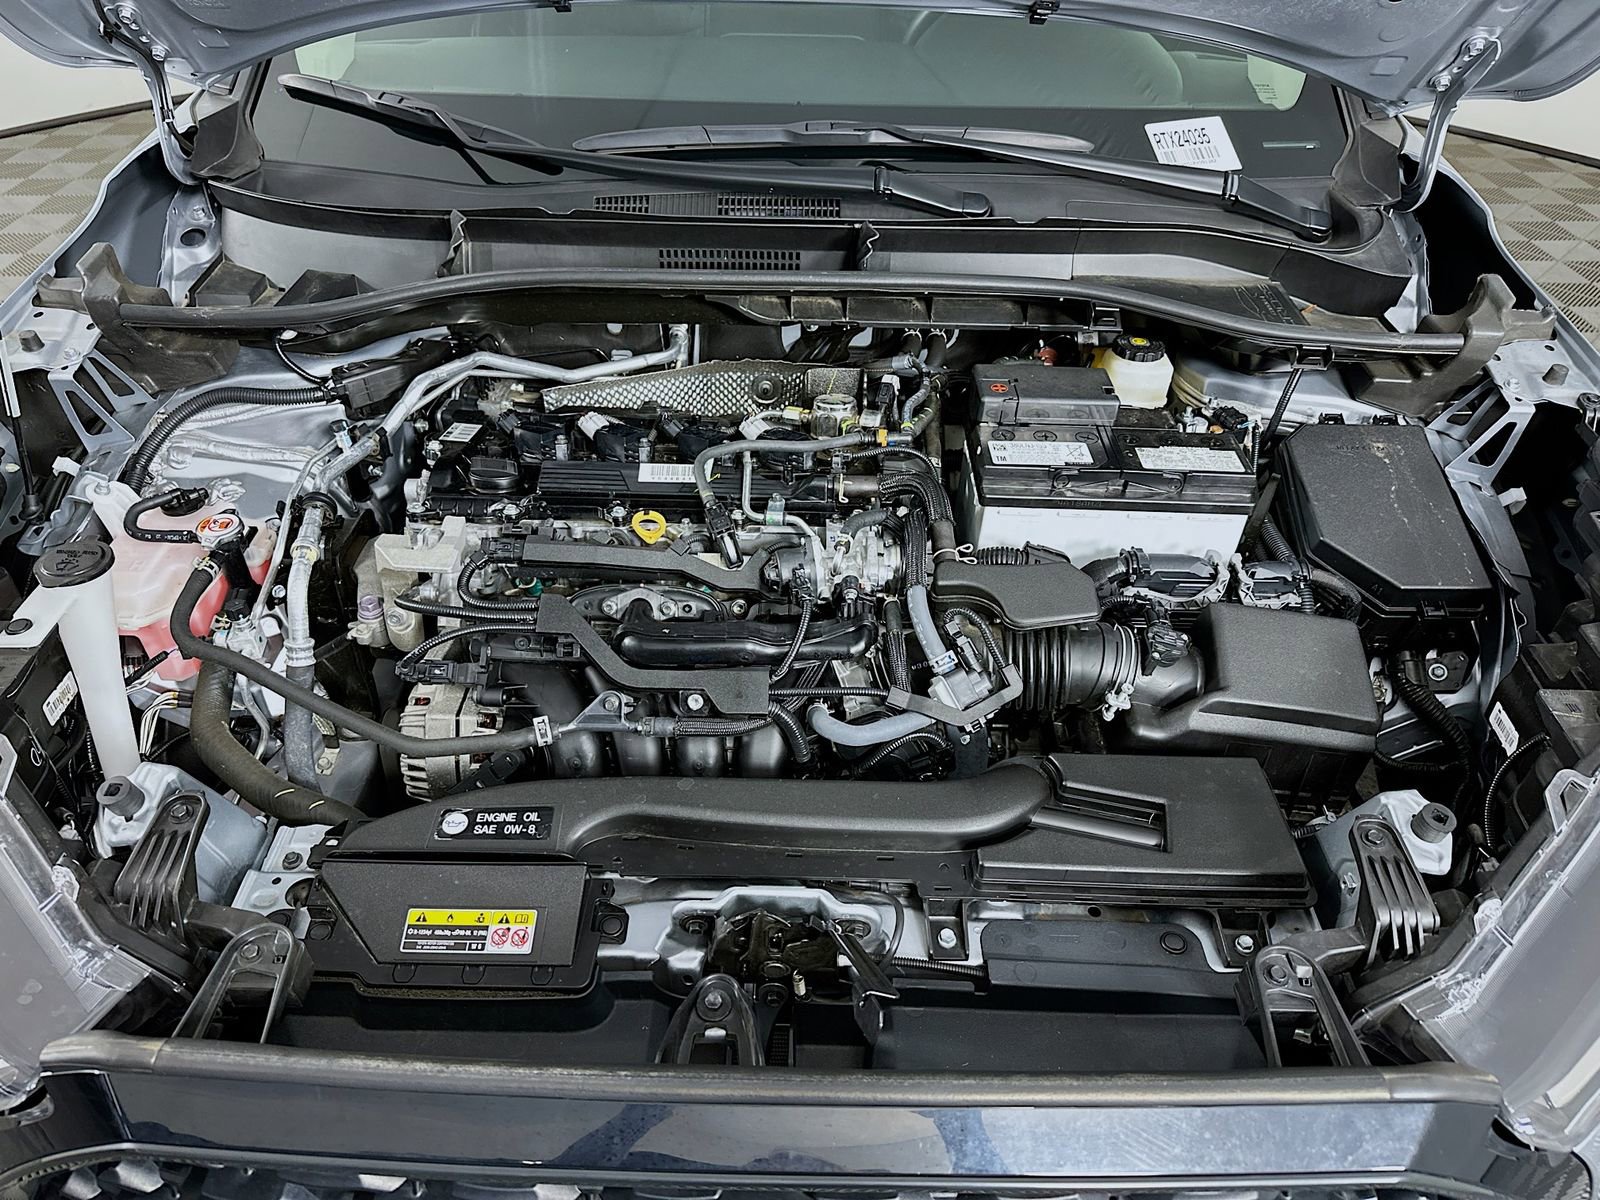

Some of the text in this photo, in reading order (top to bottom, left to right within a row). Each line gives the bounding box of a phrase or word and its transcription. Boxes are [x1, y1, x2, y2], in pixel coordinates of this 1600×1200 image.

[1153, 128, 1211, 150] RTX24035
[476, 811, 541, 822] ENGINE OIL
[473, 824, 536, 834] SAE 0W-8
